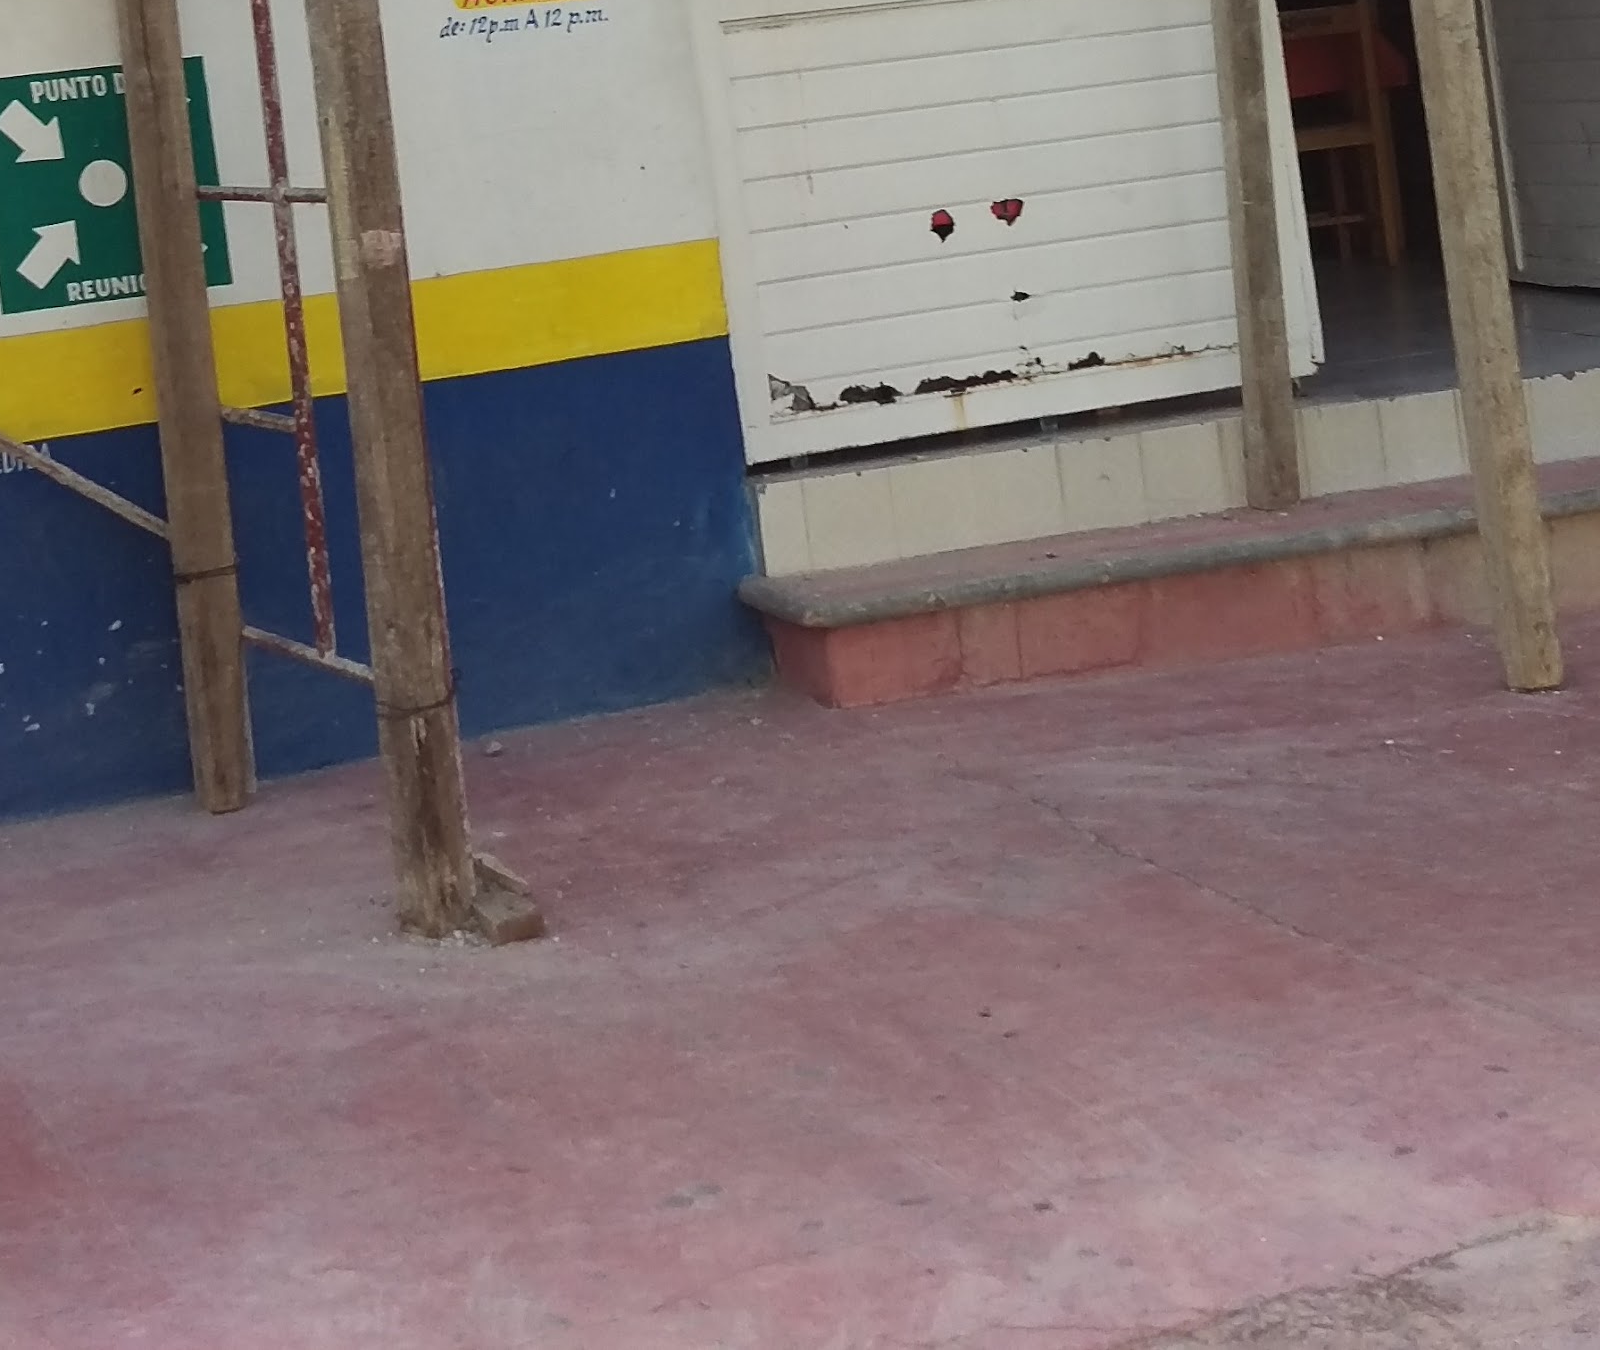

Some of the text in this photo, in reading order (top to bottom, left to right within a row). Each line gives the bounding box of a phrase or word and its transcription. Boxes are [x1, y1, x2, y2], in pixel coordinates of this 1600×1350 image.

[439, 16, 465, 38] de:
[524, 8, 539, 30] A
[545, 8, 563, 27] 12
[566, 8, 609, 34] p.m.
[30, 74, 107, 104] PUNTO
[66, 273, 147, 302] REUNI
